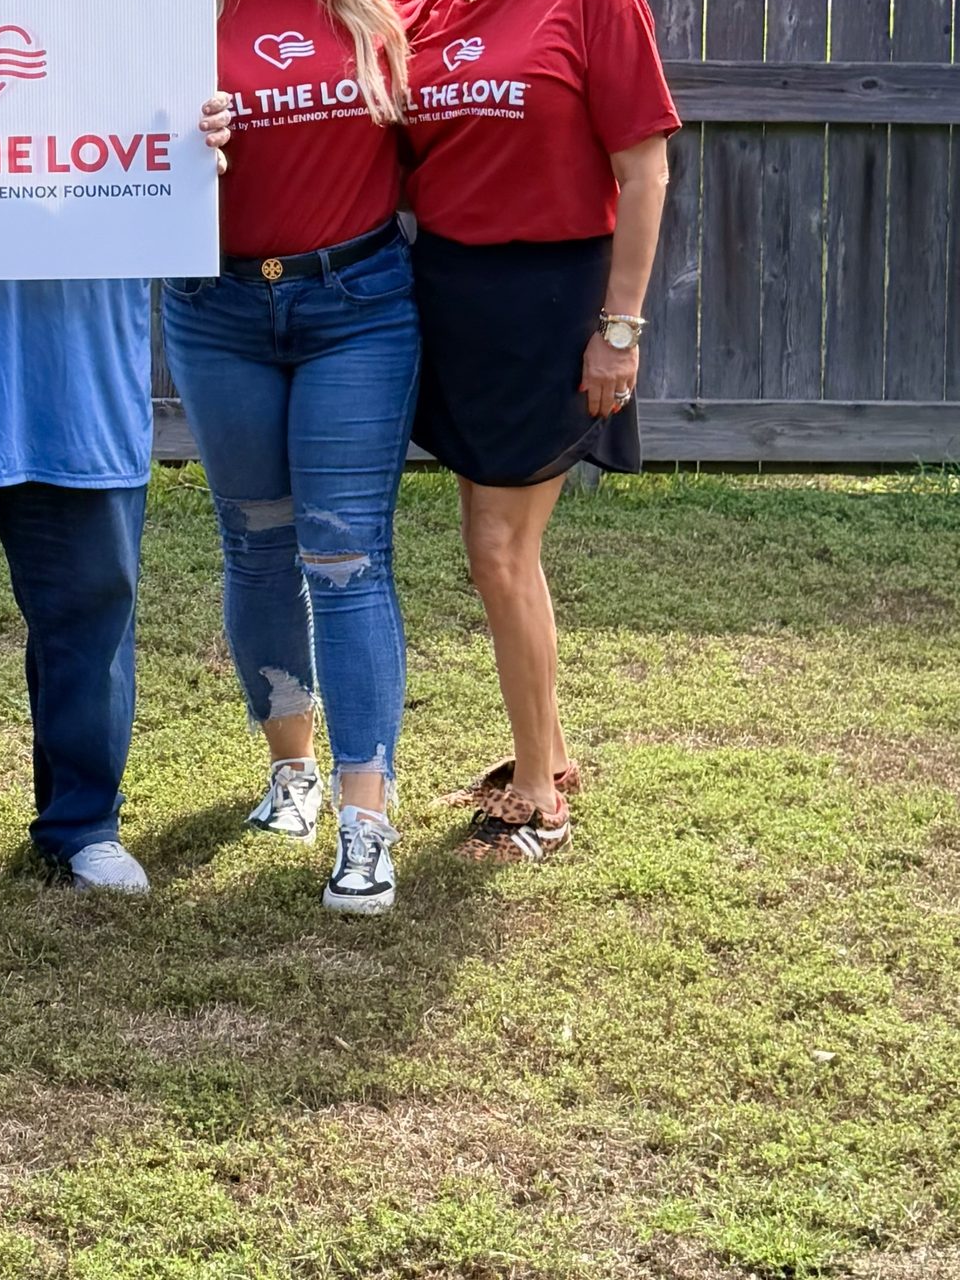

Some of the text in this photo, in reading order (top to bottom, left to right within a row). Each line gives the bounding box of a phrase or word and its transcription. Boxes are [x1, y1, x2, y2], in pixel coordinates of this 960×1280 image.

[227, 79, 358, 117] EL THE LO
[420, 83, 460, 109] THE
[462, 79, 526, 106] LOVE
[251, 119, 270, 129] THE
[287, 111, 329, 124] LENNOX
[331, 106, 369, 118] FOUNDA
[418, 113, 432, 122] THE
[47, 133, 171, 173] LOVE
[63, 183, 171, 198] FOUNDATION
